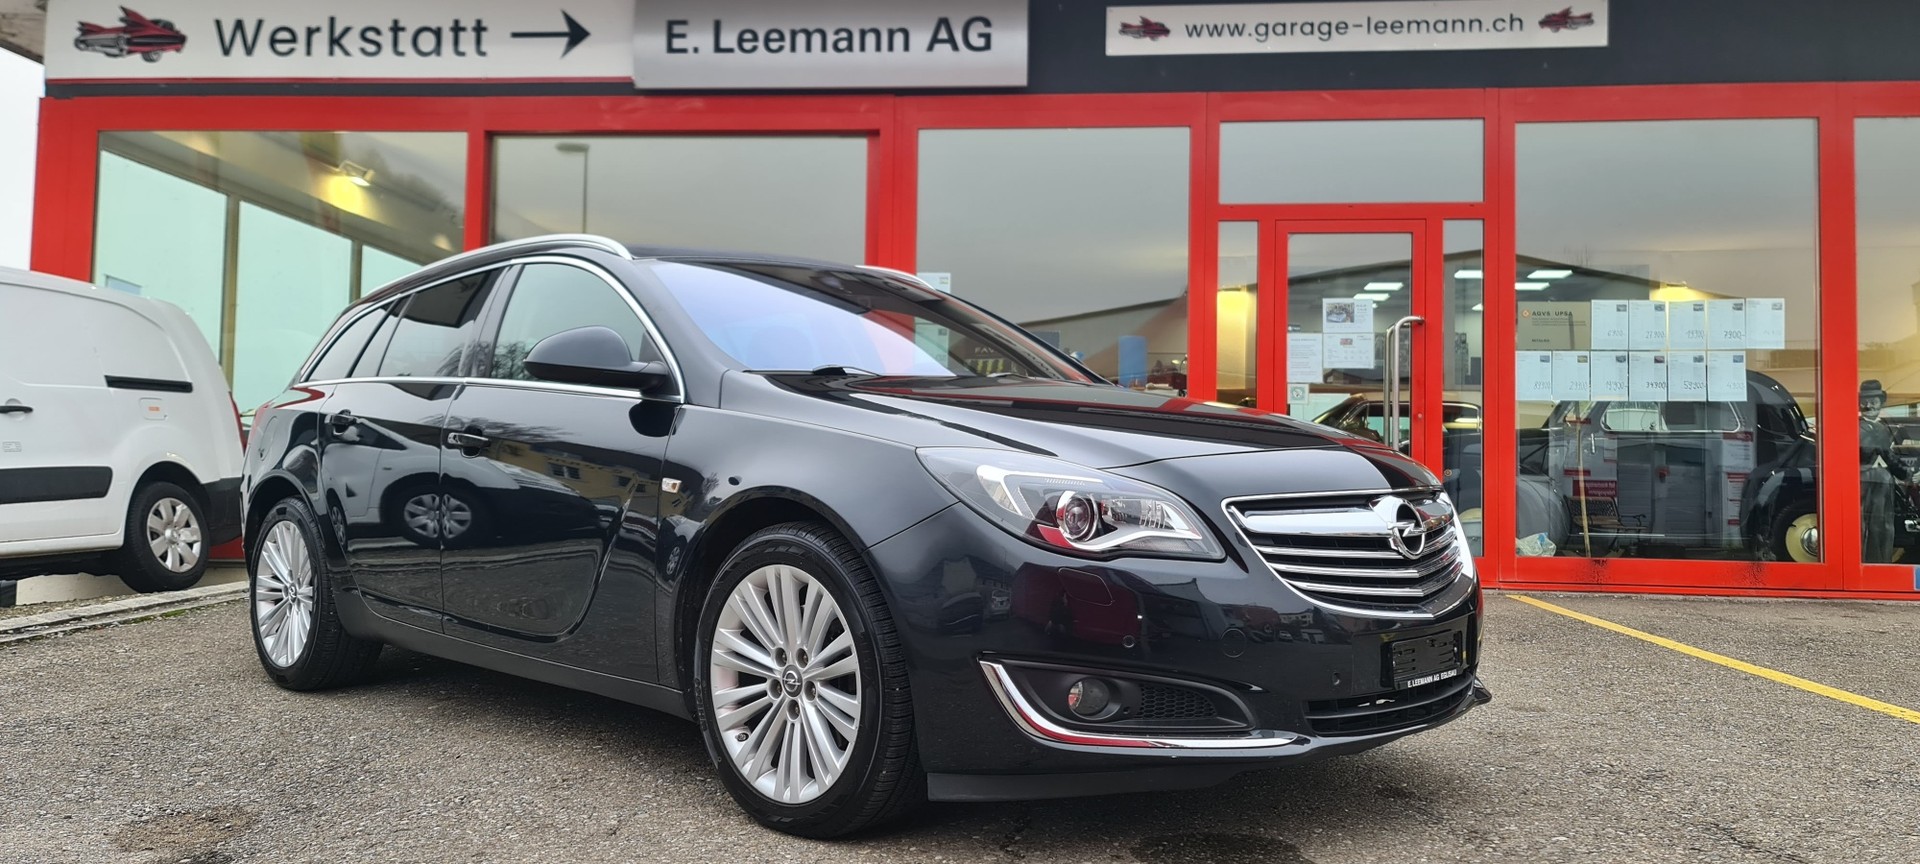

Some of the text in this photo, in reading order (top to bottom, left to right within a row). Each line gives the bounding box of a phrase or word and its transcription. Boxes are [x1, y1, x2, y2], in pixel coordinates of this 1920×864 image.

[215, 16, 488, 57] Werkstatt
[666, 15, 993, 54] E. Leemann AG
[1185, 13, 1524, 42] www.garage-leemann.ch
[1412, 676, 1433, 687] LEEMANN
